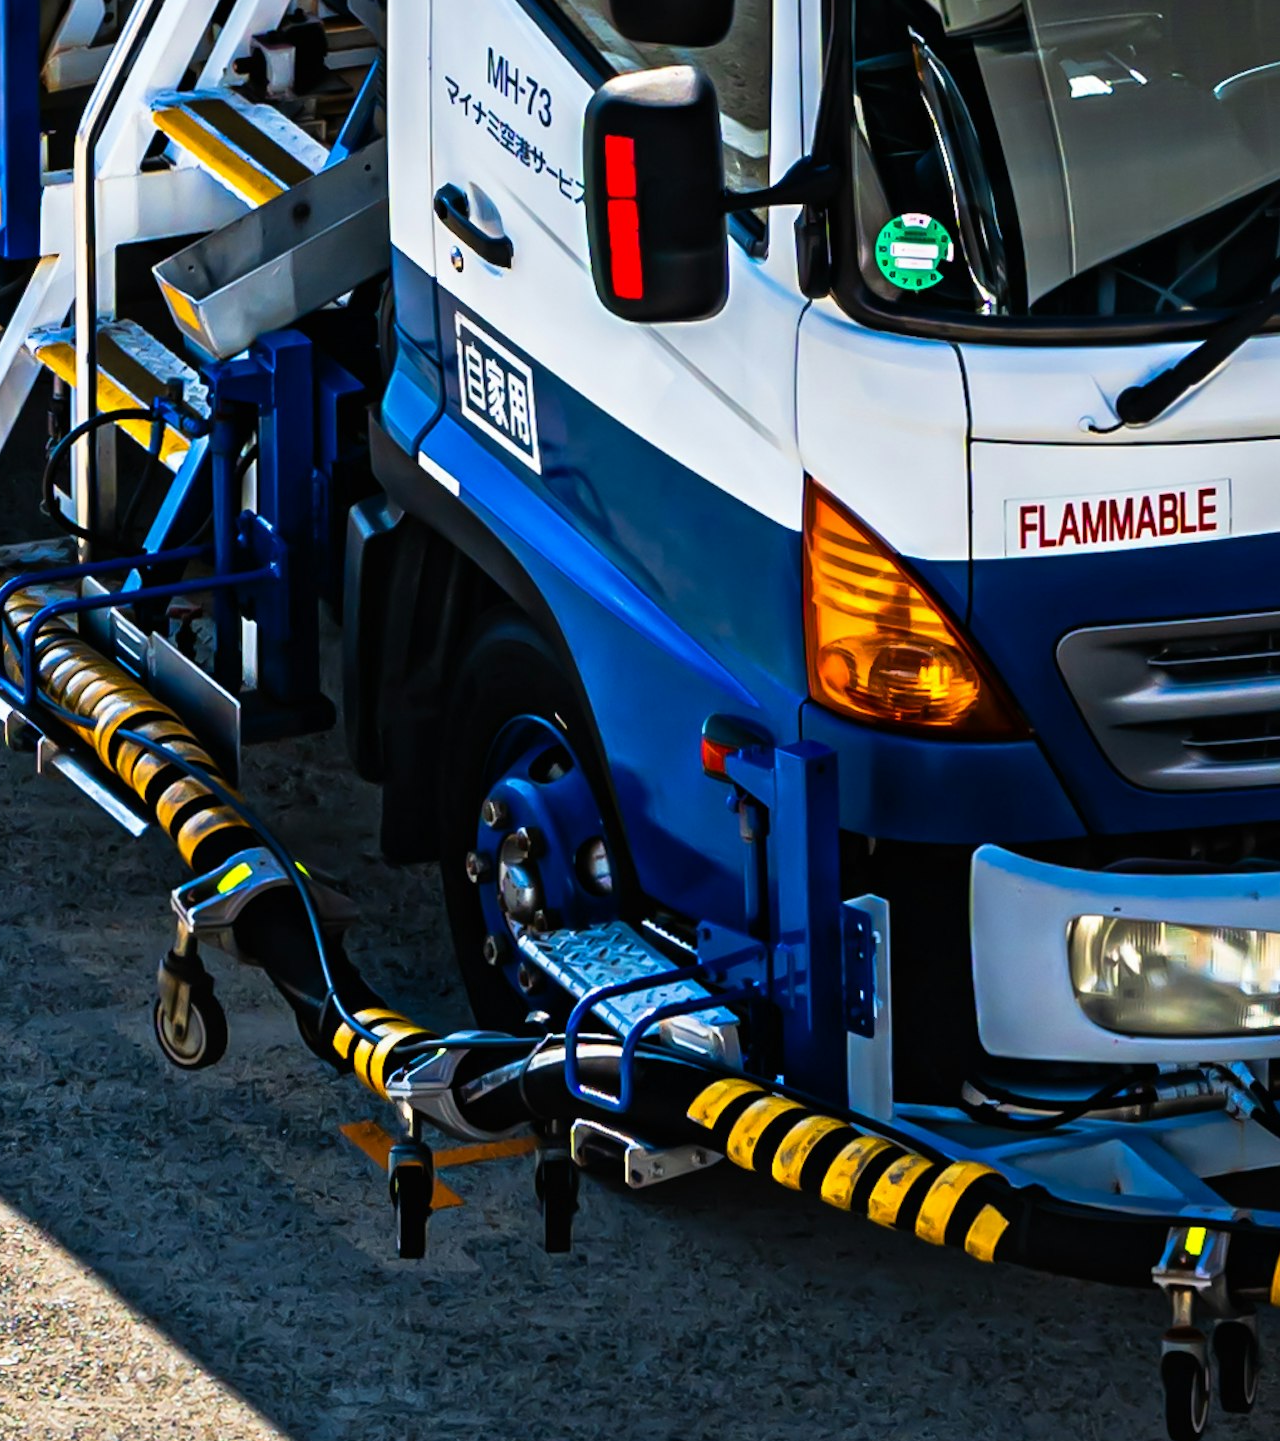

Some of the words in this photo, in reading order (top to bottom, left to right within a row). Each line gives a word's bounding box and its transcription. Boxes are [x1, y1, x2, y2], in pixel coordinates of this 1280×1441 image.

[487, 46, 552, 128] MH-73
[465, 340, 531, 446] 自家用
[1019, 487, 1217, 550] FLAMMABLE
